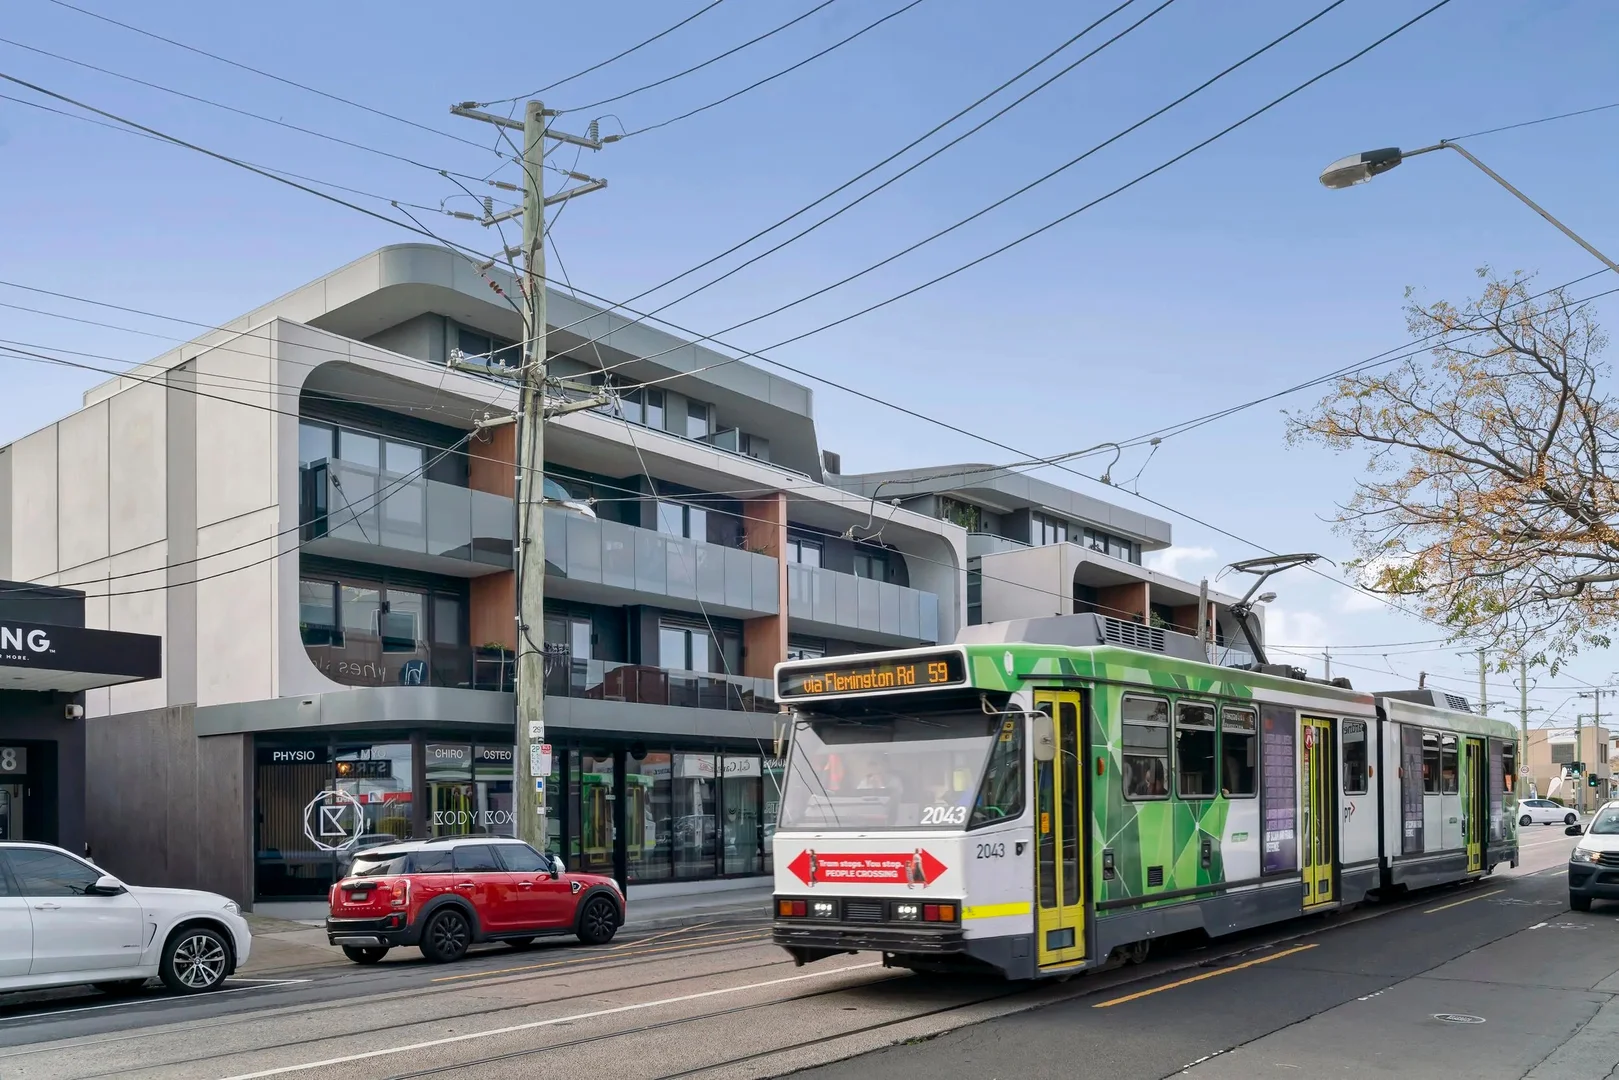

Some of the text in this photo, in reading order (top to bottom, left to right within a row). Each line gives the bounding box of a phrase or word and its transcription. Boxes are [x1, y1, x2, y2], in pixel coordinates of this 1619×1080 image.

[804, 662, 948, 693] via Flemington Rd 59
[273, 750, 316, 761] PHYSIO
[435, 748, 464, 759] CHIRO
[483, 750, 512, 760] OSTEO
[920, 806, 967, 825] 2043
[976, 842, 1005, 859] 2043
[864, 859, 881, 868] You
[825, 870, 898, 878] PEOPLE CROSSING
